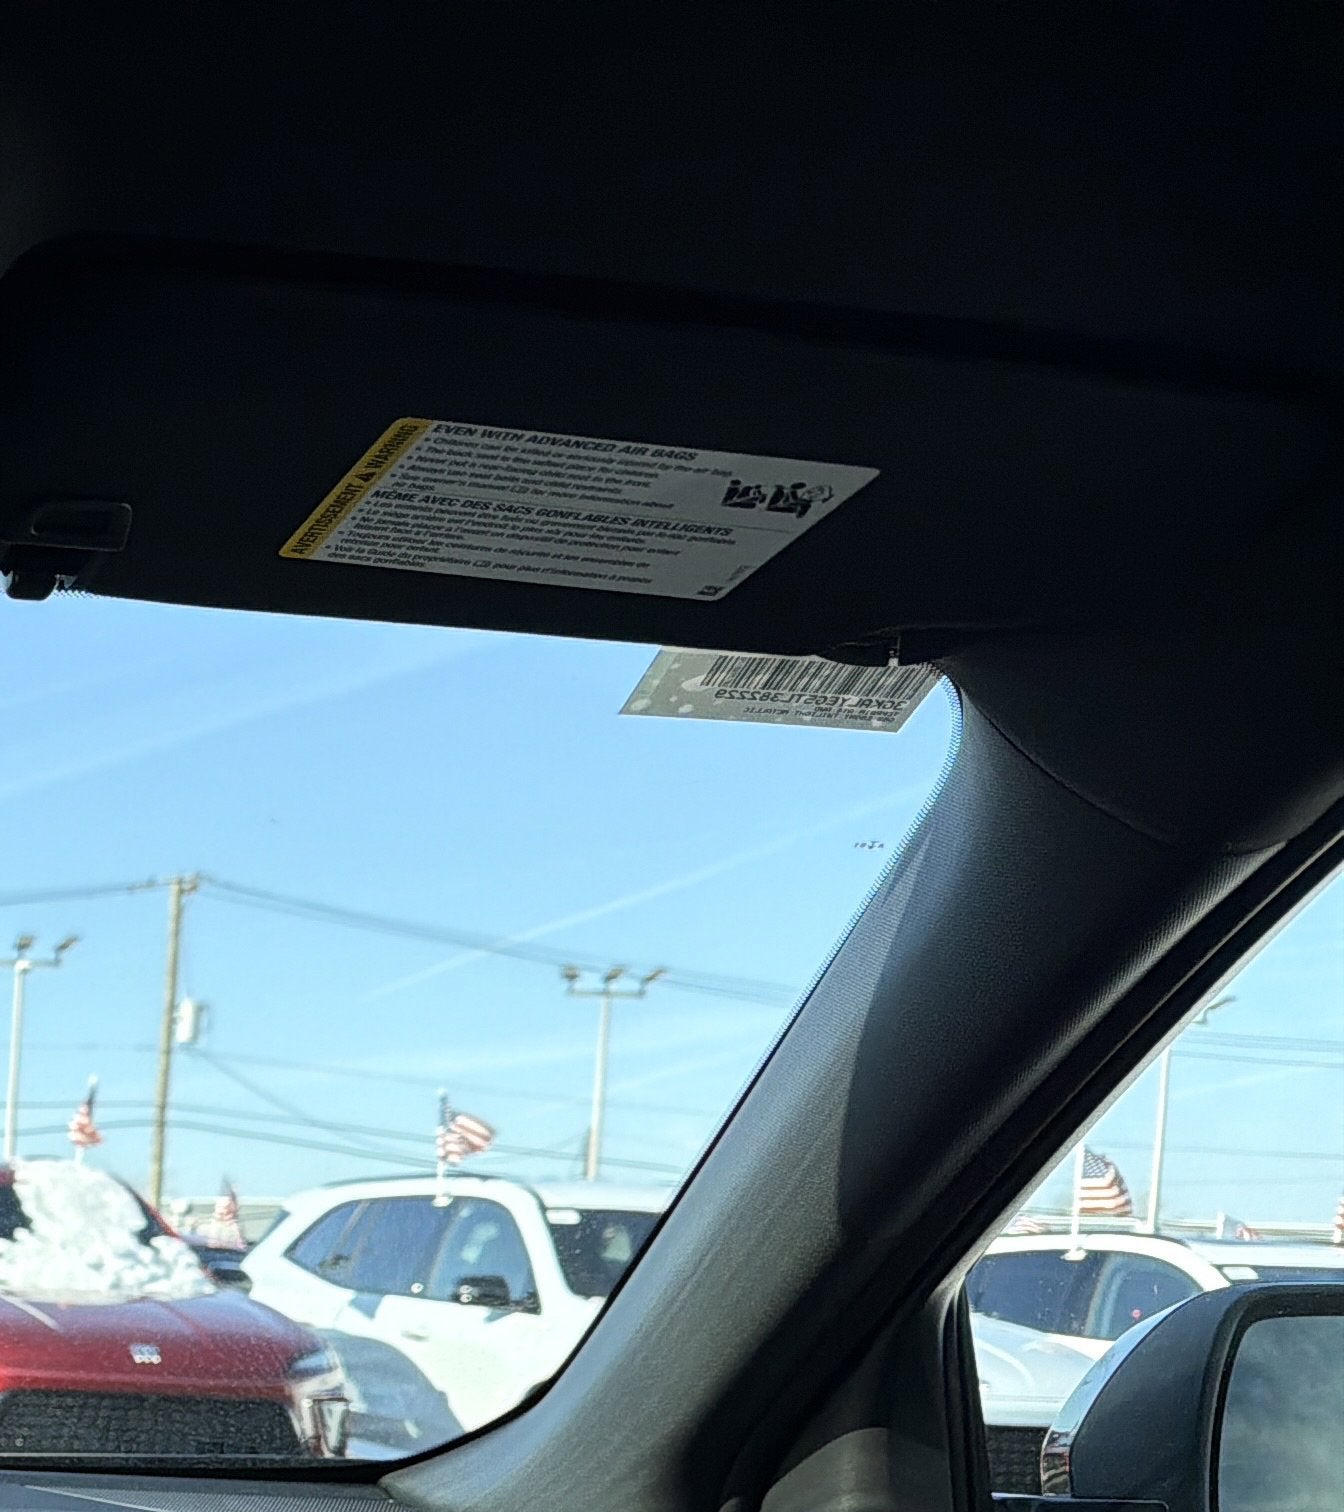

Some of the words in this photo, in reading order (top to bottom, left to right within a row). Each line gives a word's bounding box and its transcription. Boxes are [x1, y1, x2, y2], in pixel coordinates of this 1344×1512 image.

[431, 424, 479, 436] EVEN
[476, 429, 525, 441] WITH
[524, 435, 618, 451] ADVANCED
[616, 445, 650, 455] AIR
[648, 448, 700, 460] BAGS
[291, 482, 364, 555] AVERTISSEMENT
[370, 488, 422, 501] MÊME
[417, 495, 461, 506] AVEC
[459, 500, 494, 509] DES
[492, 503, 535, 514] SACS
[533, 508, 632, 525] GONFLABLES
[631, 517, 734, 536] INTELLIGENTS
